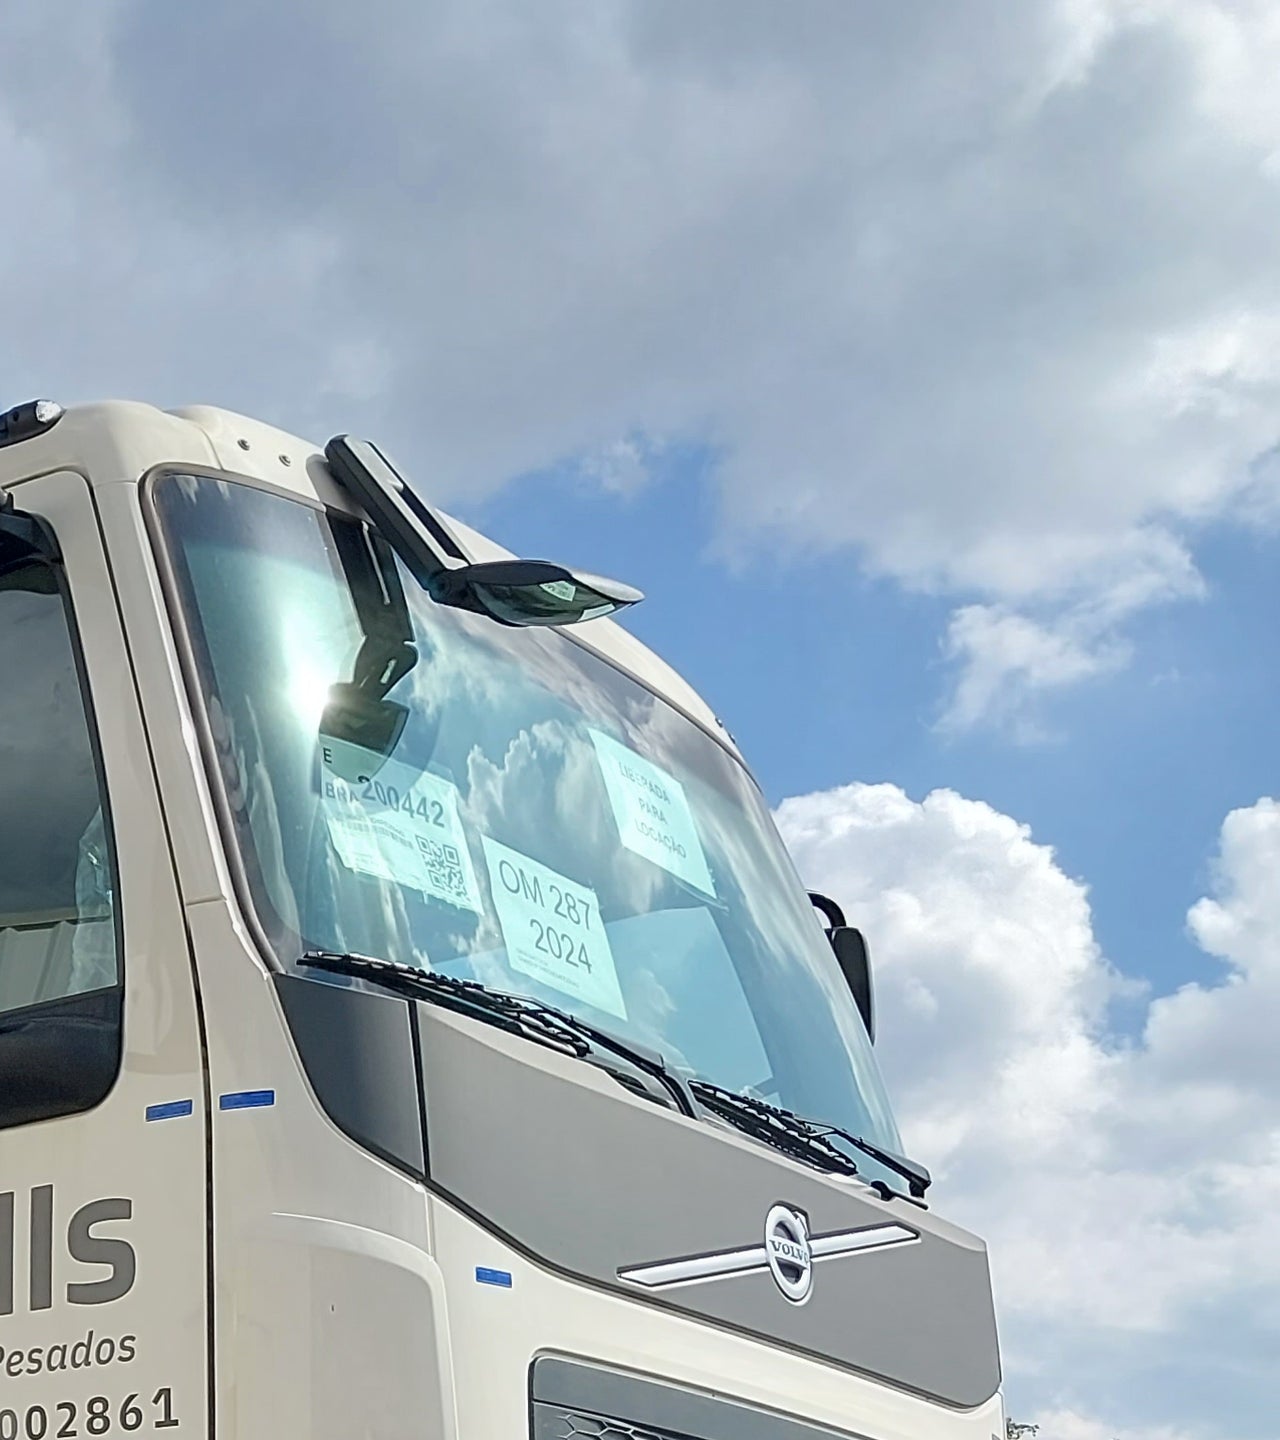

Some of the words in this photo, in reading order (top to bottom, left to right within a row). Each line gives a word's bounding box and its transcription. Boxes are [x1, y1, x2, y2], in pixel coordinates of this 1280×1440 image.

[357, 775, 446, 829] 200442
[618, 761, 671, 806] LIBERADA
[637, 797, 669, 826] PARA
[634, 817, 688, 859] LOCAÇÃO
[499, 860, 545, 909] OM
[549, 885, 591, 931] 287
[529, 918, 593, 975] 2024
[769, 1239, 810, 1265] VOLVO
